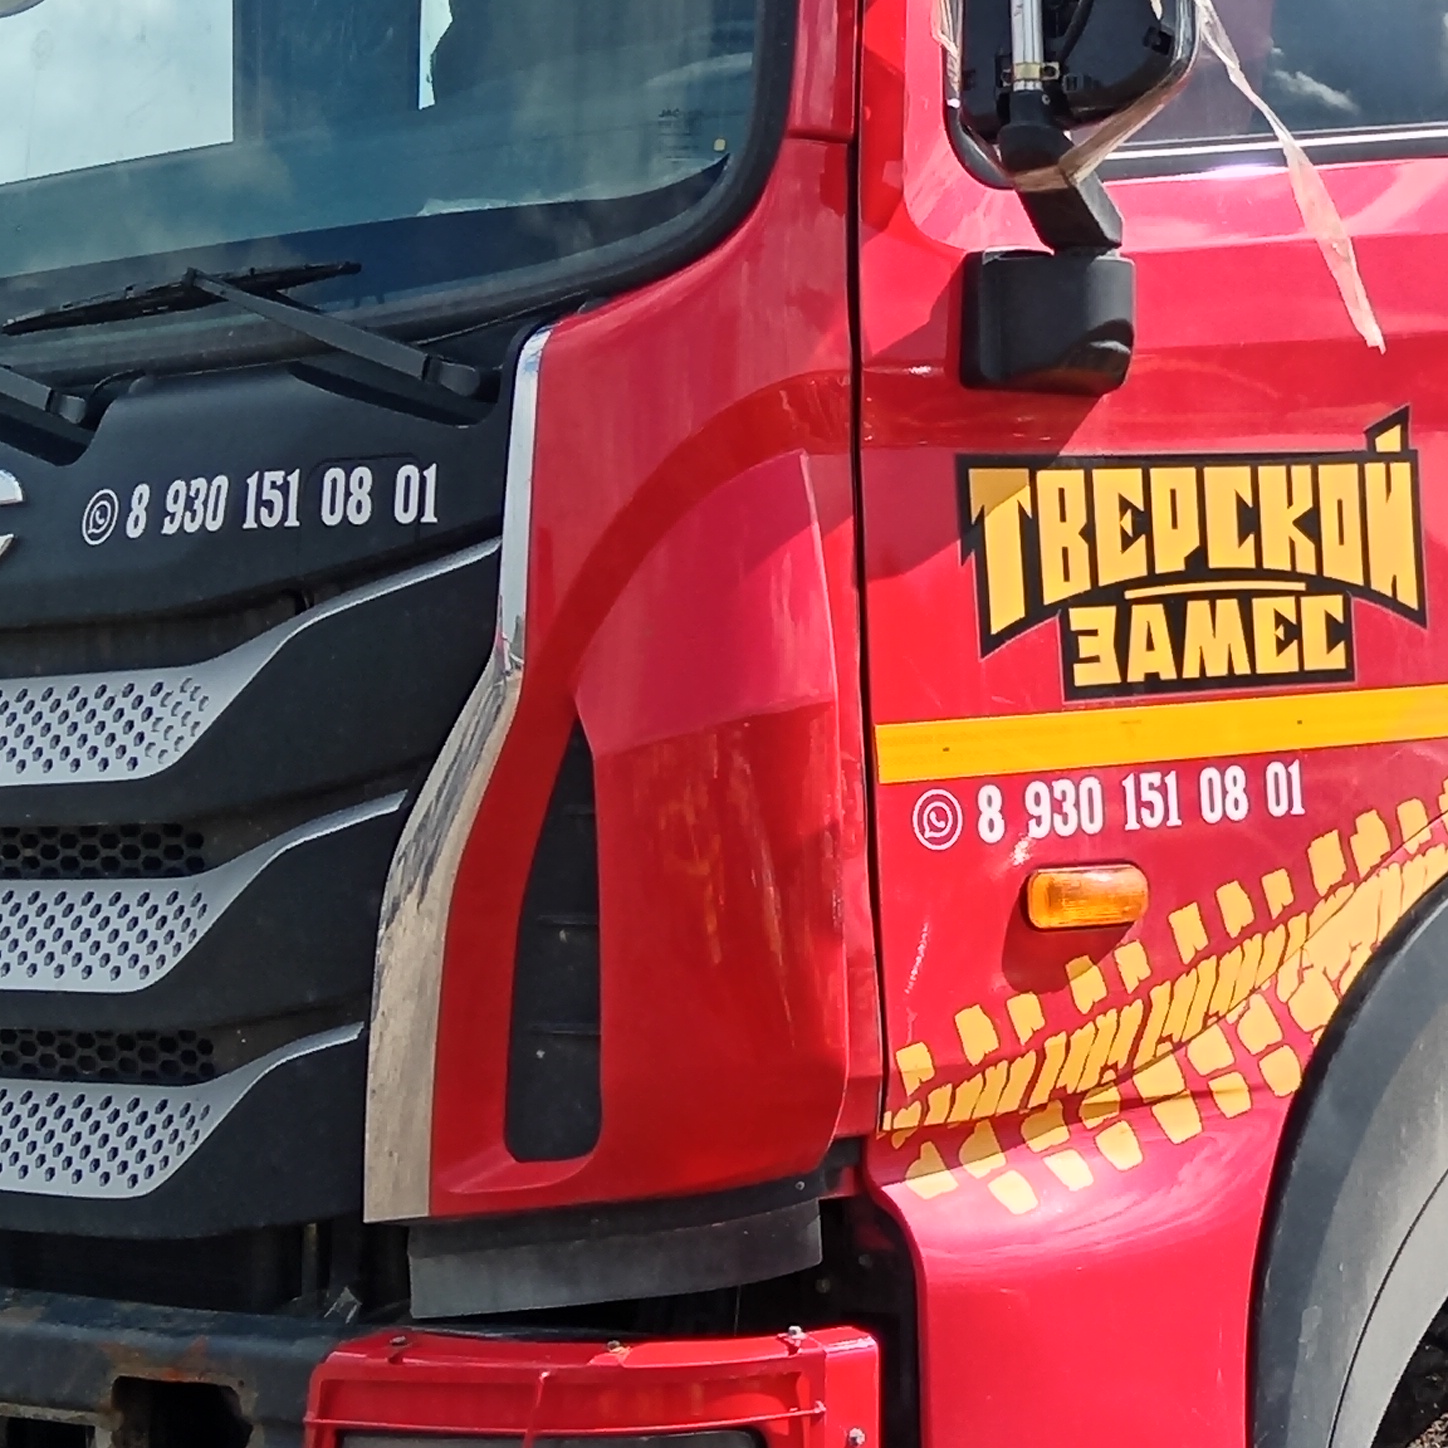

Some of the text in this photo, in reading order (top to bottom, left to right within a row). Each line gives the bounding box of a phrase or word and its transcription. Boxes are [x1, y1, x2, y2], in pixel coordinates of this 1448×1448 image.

[125, 462, 438, 540] 8 930 151 08 01
[968, 424, 1420, 636] ТВЕРСКОЙ
[1068, 594, 1347, 688] ЗАМЕС
[976, 757, 1306, 844] 8 930 151 08 01
